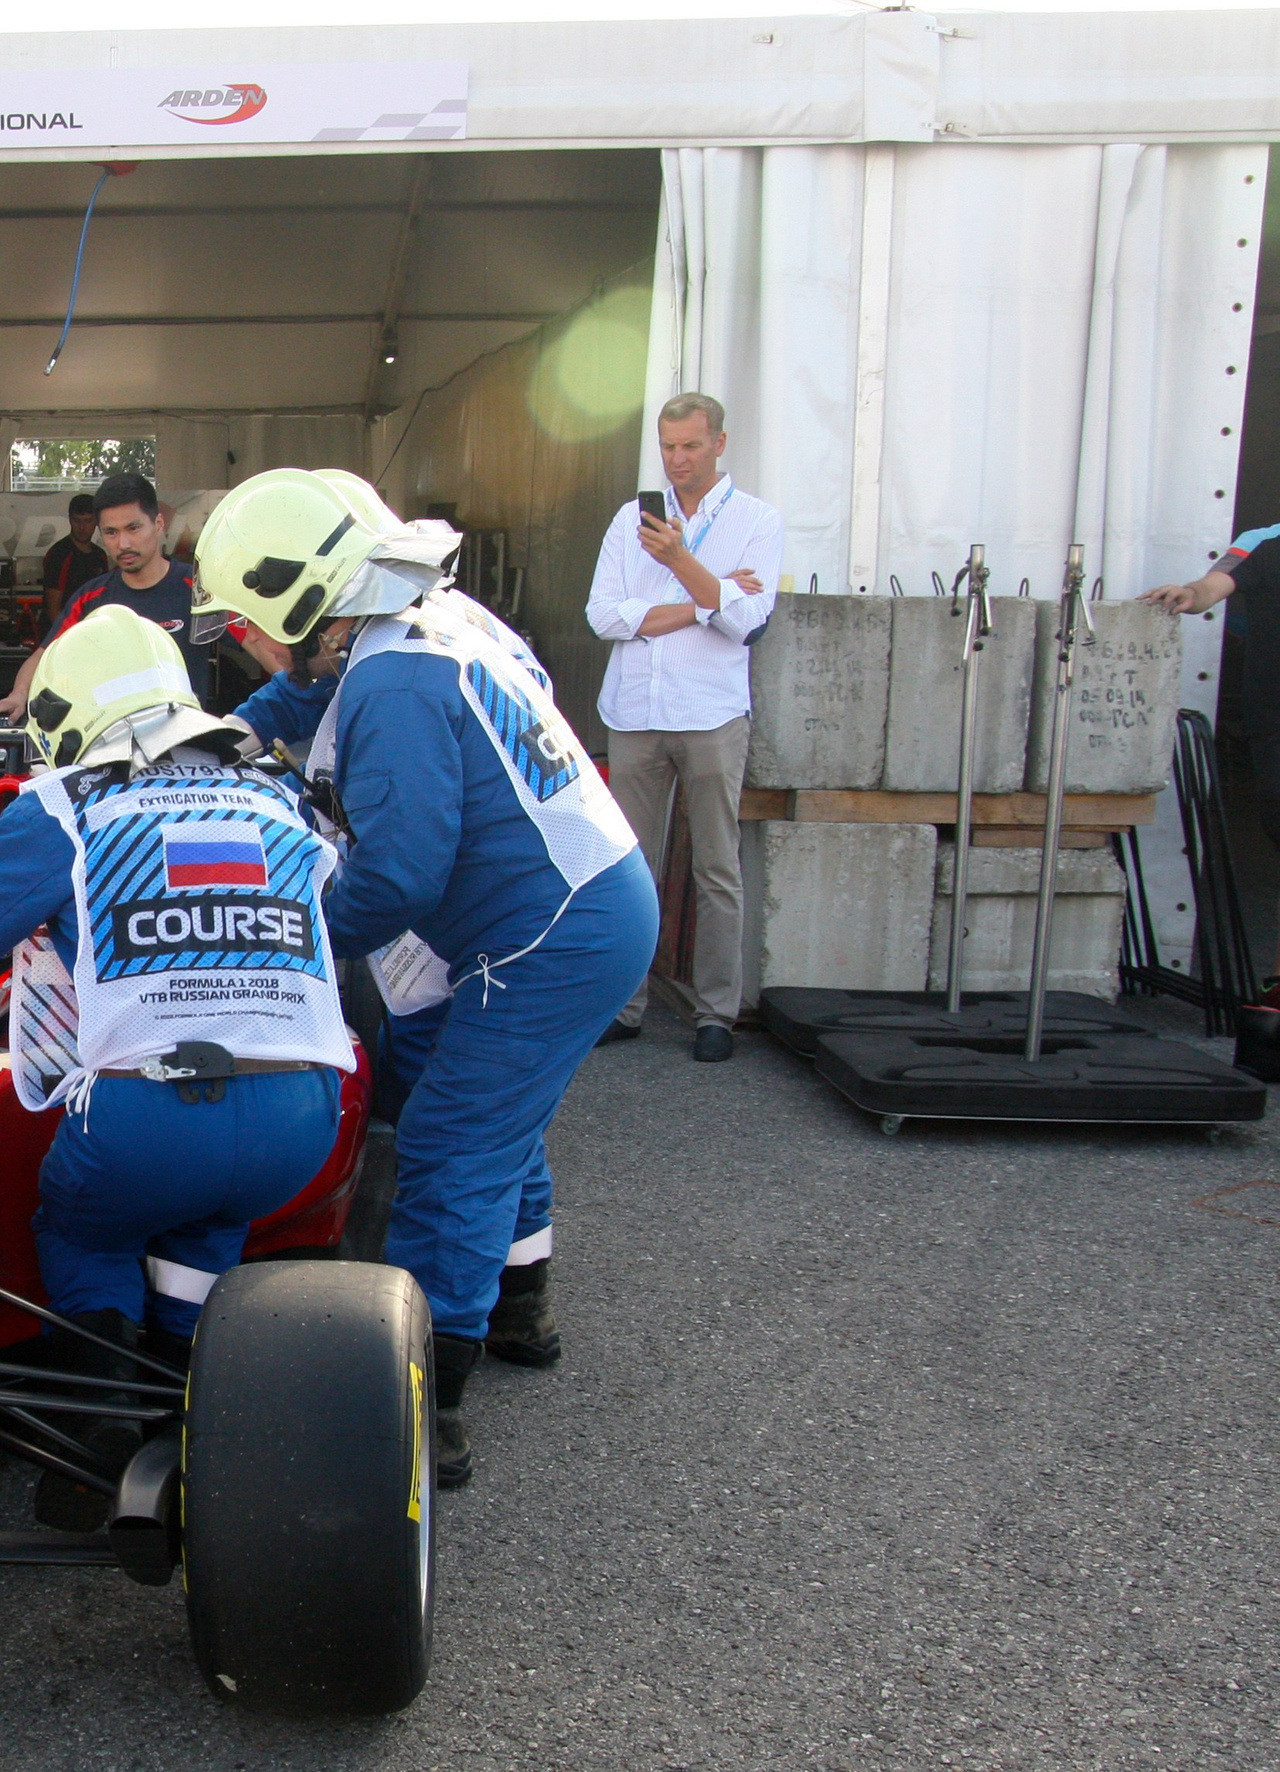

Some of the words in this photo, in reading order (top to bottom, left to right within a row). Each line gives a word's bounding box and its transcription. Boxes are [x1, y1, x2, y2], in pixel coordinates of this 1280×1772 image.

[157, 88, 266, 108] ARDEN
[138, 793, 219, 808] EXTRICATION
[222, 794, 255, 806] TEAM
[127, 905, 304, 947] COURSE
[169, 978, 236, 989] FORMULA
[238, 978, 246, 987] 1
[248, 978, 279, 989] 2018
[139, 992, 168, 1004] VTB
[170, 990, 230, 1002] RUSSIAN
[232, 989, 279, 1001] GRAND
[280, 991, 307, 1005] PRIX
